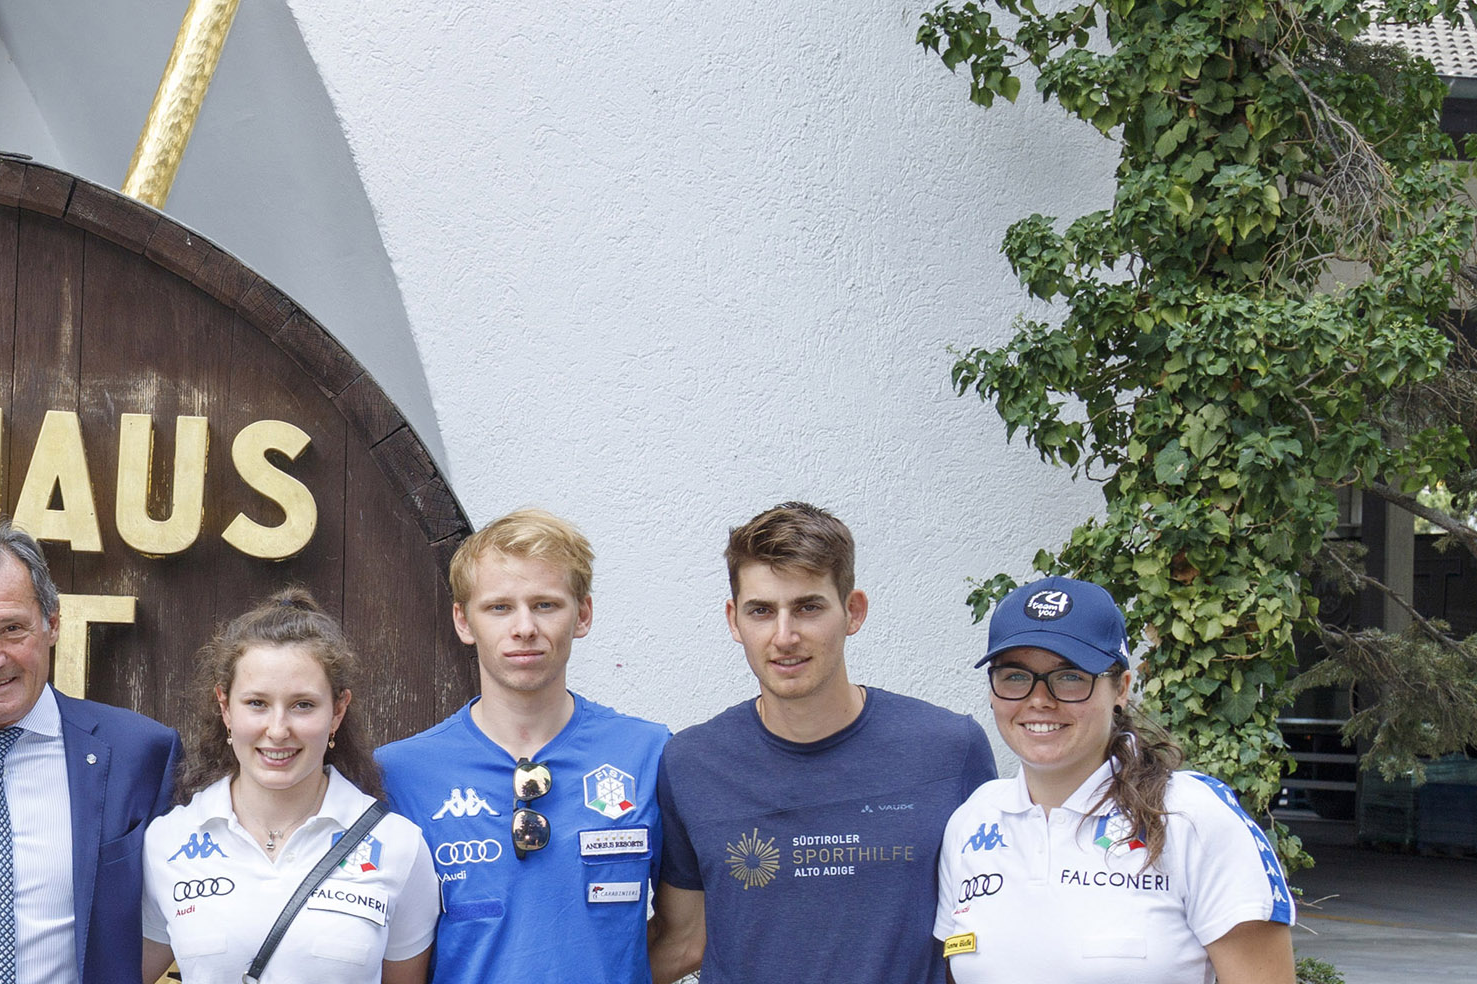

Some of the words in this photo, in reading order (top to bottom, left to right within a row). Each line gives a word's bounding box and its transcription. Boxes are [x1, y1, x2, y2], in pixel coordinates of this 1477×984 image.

[1032, 602, 1058, 611] team
[1045, 591, 1069, 612] 4
[1038, 609, 1056, 617] you
[595, 769, 624, 781] FISI
[585, 841, 614, 850] ANDREUS
[615, 840, 644, 848] RESORTS
[792, 834, 860, 846] SÜDTIROLER
[792, 846, 914, 864] SPORTHILFE
[443, 870, 466, 881] Audi
[794, 867, 820, 877] ALTO
[823, 866, 855, 876] ADIGE
[1061, 869, 1169, 891] FALCONERI
[310, 888, 386, 914] FALCONERI
[175, 905, 196, 917] Audi
